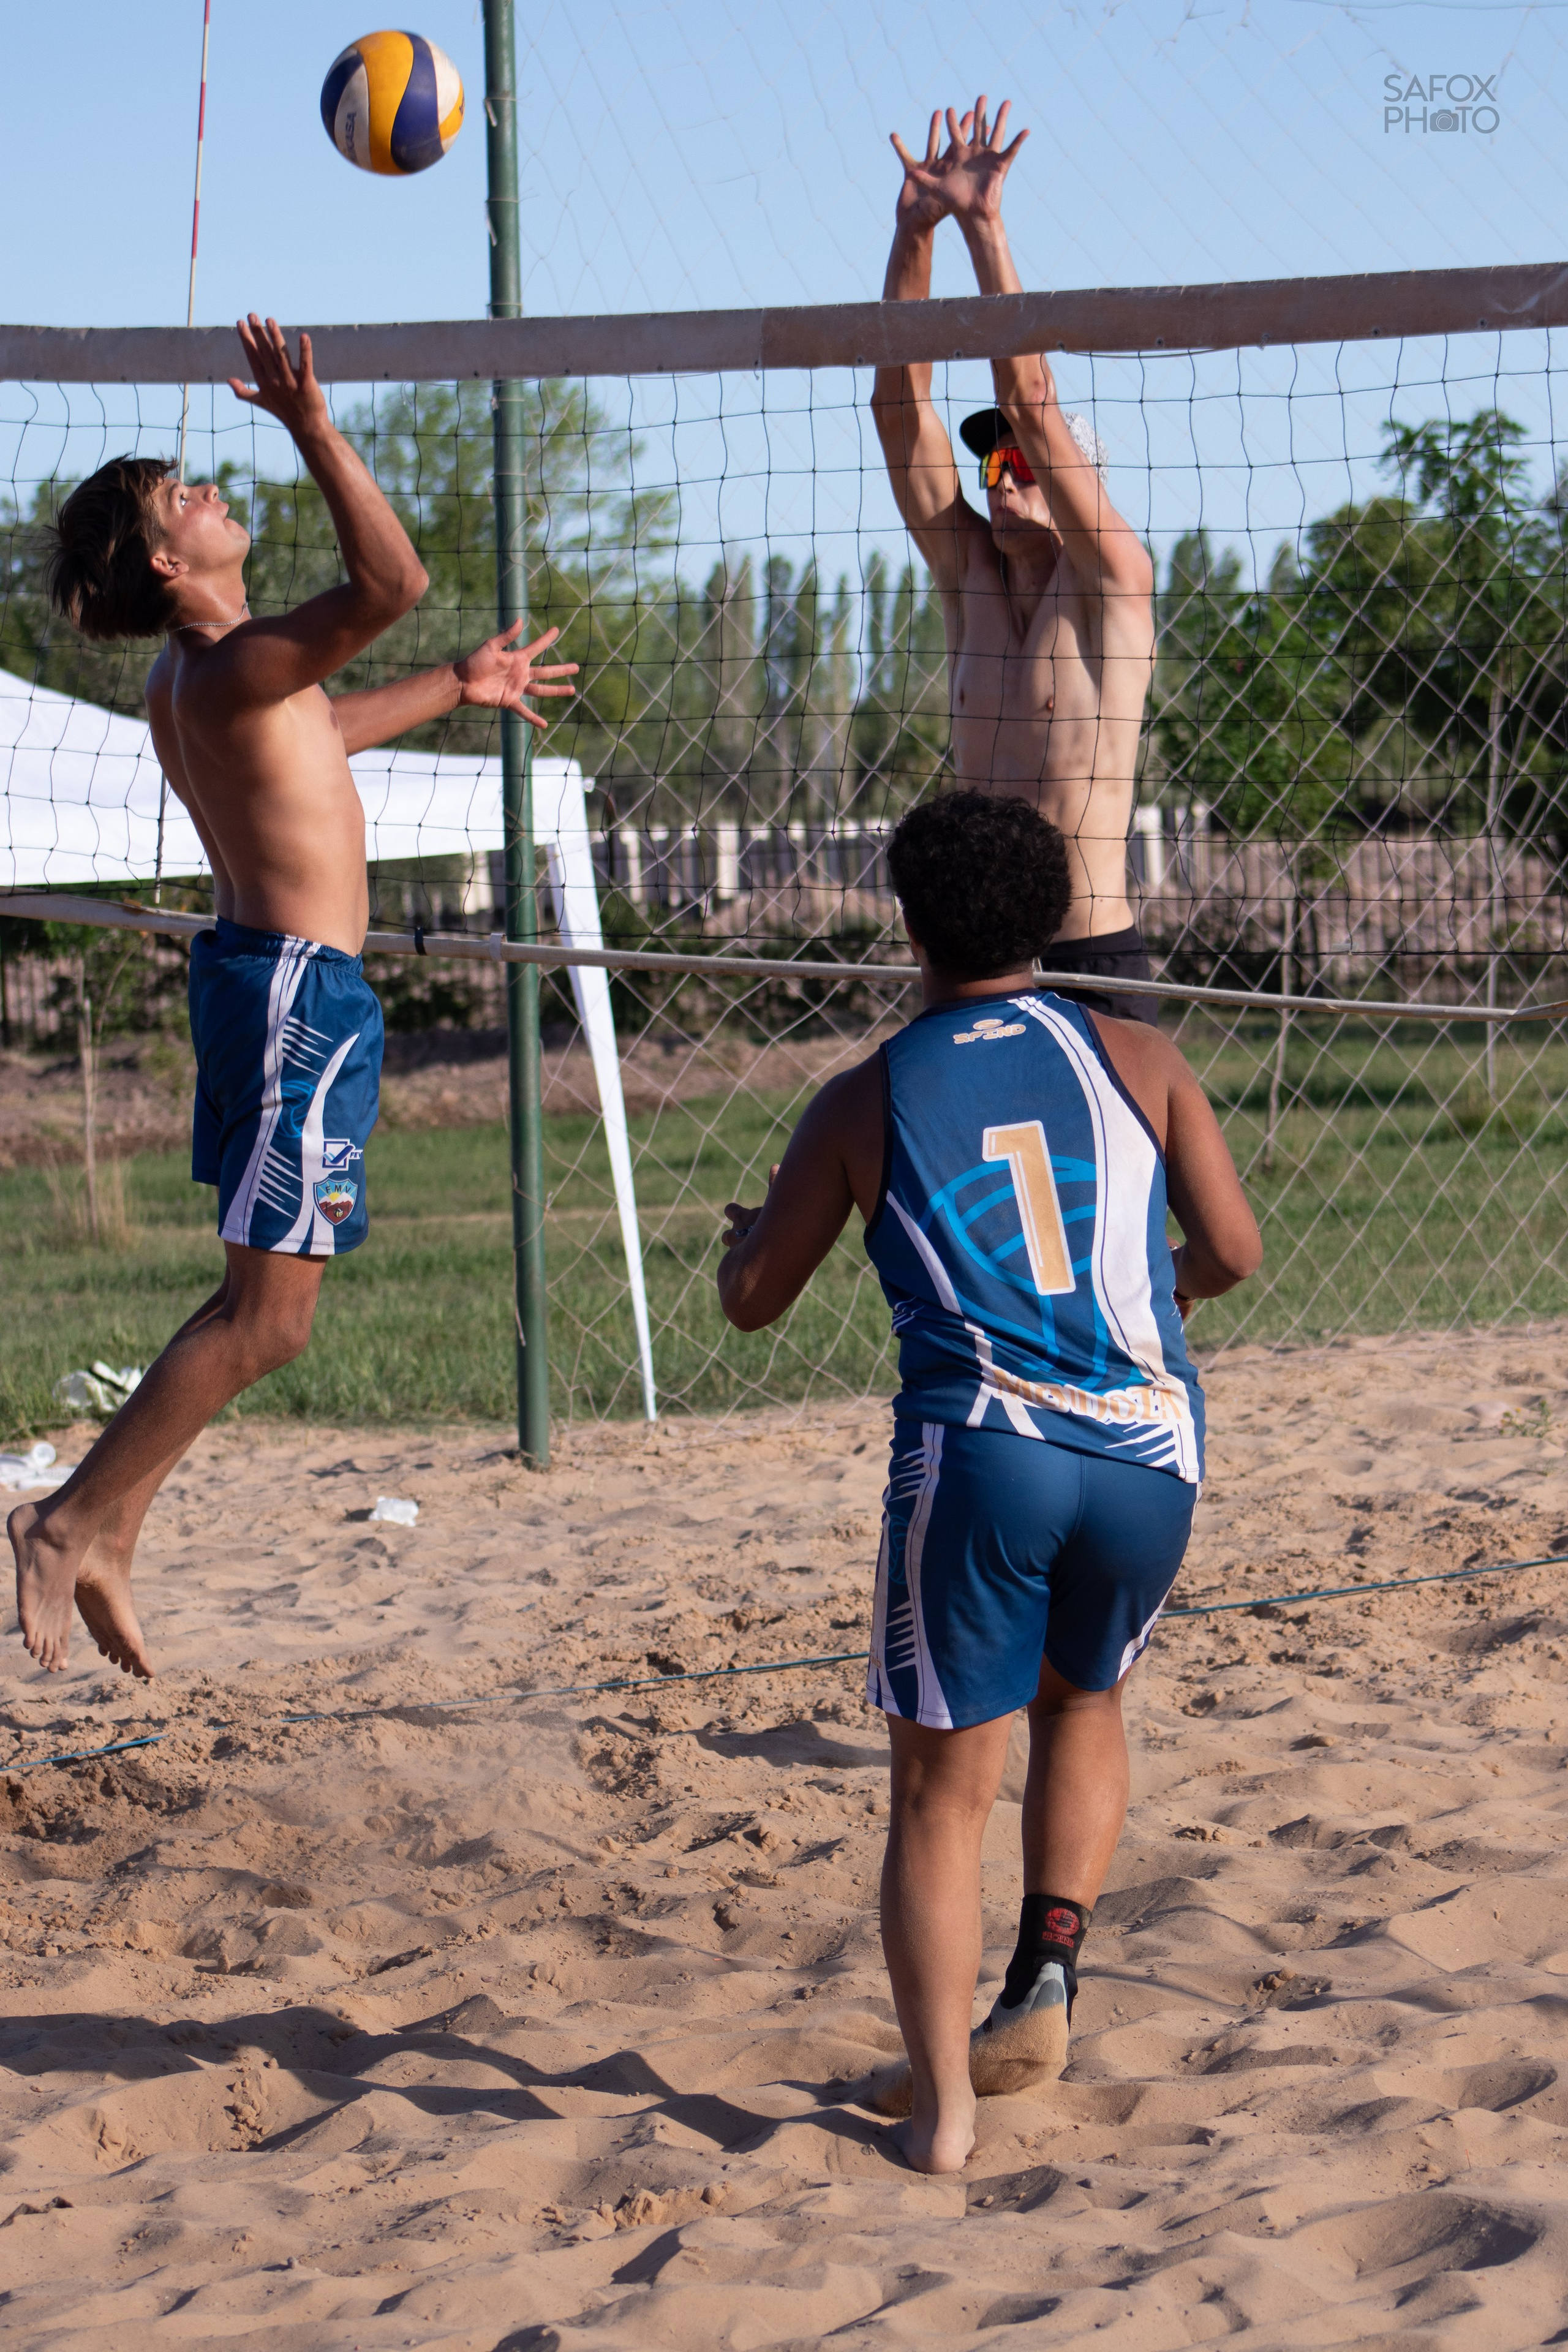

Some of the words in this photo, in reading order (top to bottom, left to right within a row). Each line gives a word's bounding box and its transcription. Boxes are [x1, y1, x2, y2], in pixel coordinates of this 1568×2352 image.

[953, 1023, 1026, 1044] SPIND
[982, 1120, 1077, 1296] 1
[991, 1368, 1183, 1422] MENDOZA
